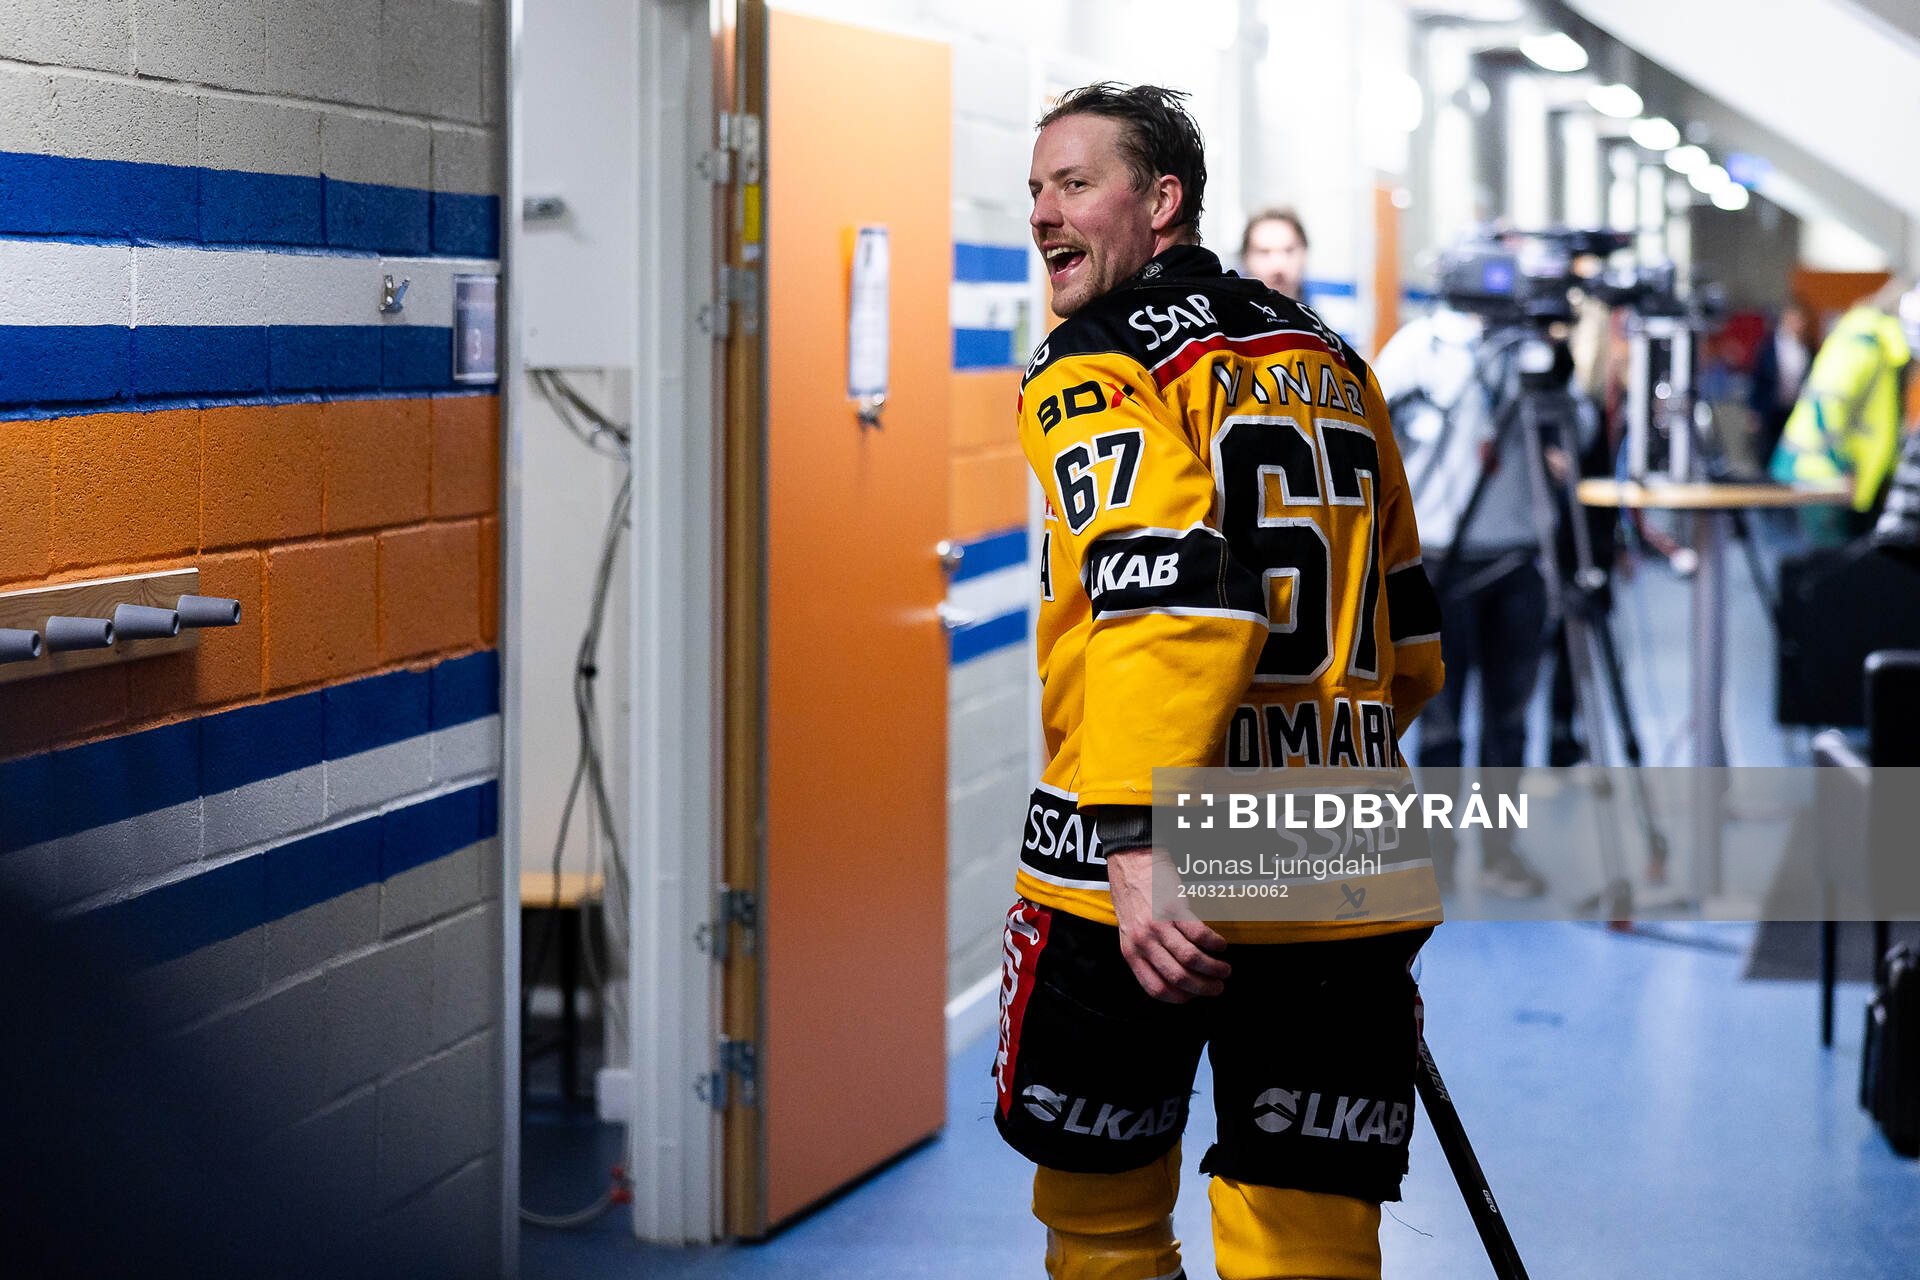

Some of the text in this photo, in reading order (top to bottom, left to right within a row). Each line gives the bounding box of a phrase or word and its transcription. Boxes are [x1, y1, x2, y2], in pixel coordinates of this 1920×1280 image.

[1128, 294, 1218, 351] SSAB
[1054, 428, 1146, 536] 67
[1091, 552, 1179, 600] LKAB
[1211, 415, 1383, 683] 67
[1063, 1096, 1181, 1141] LKAB
[1301, 1092, 1408, 1146] LKAB
